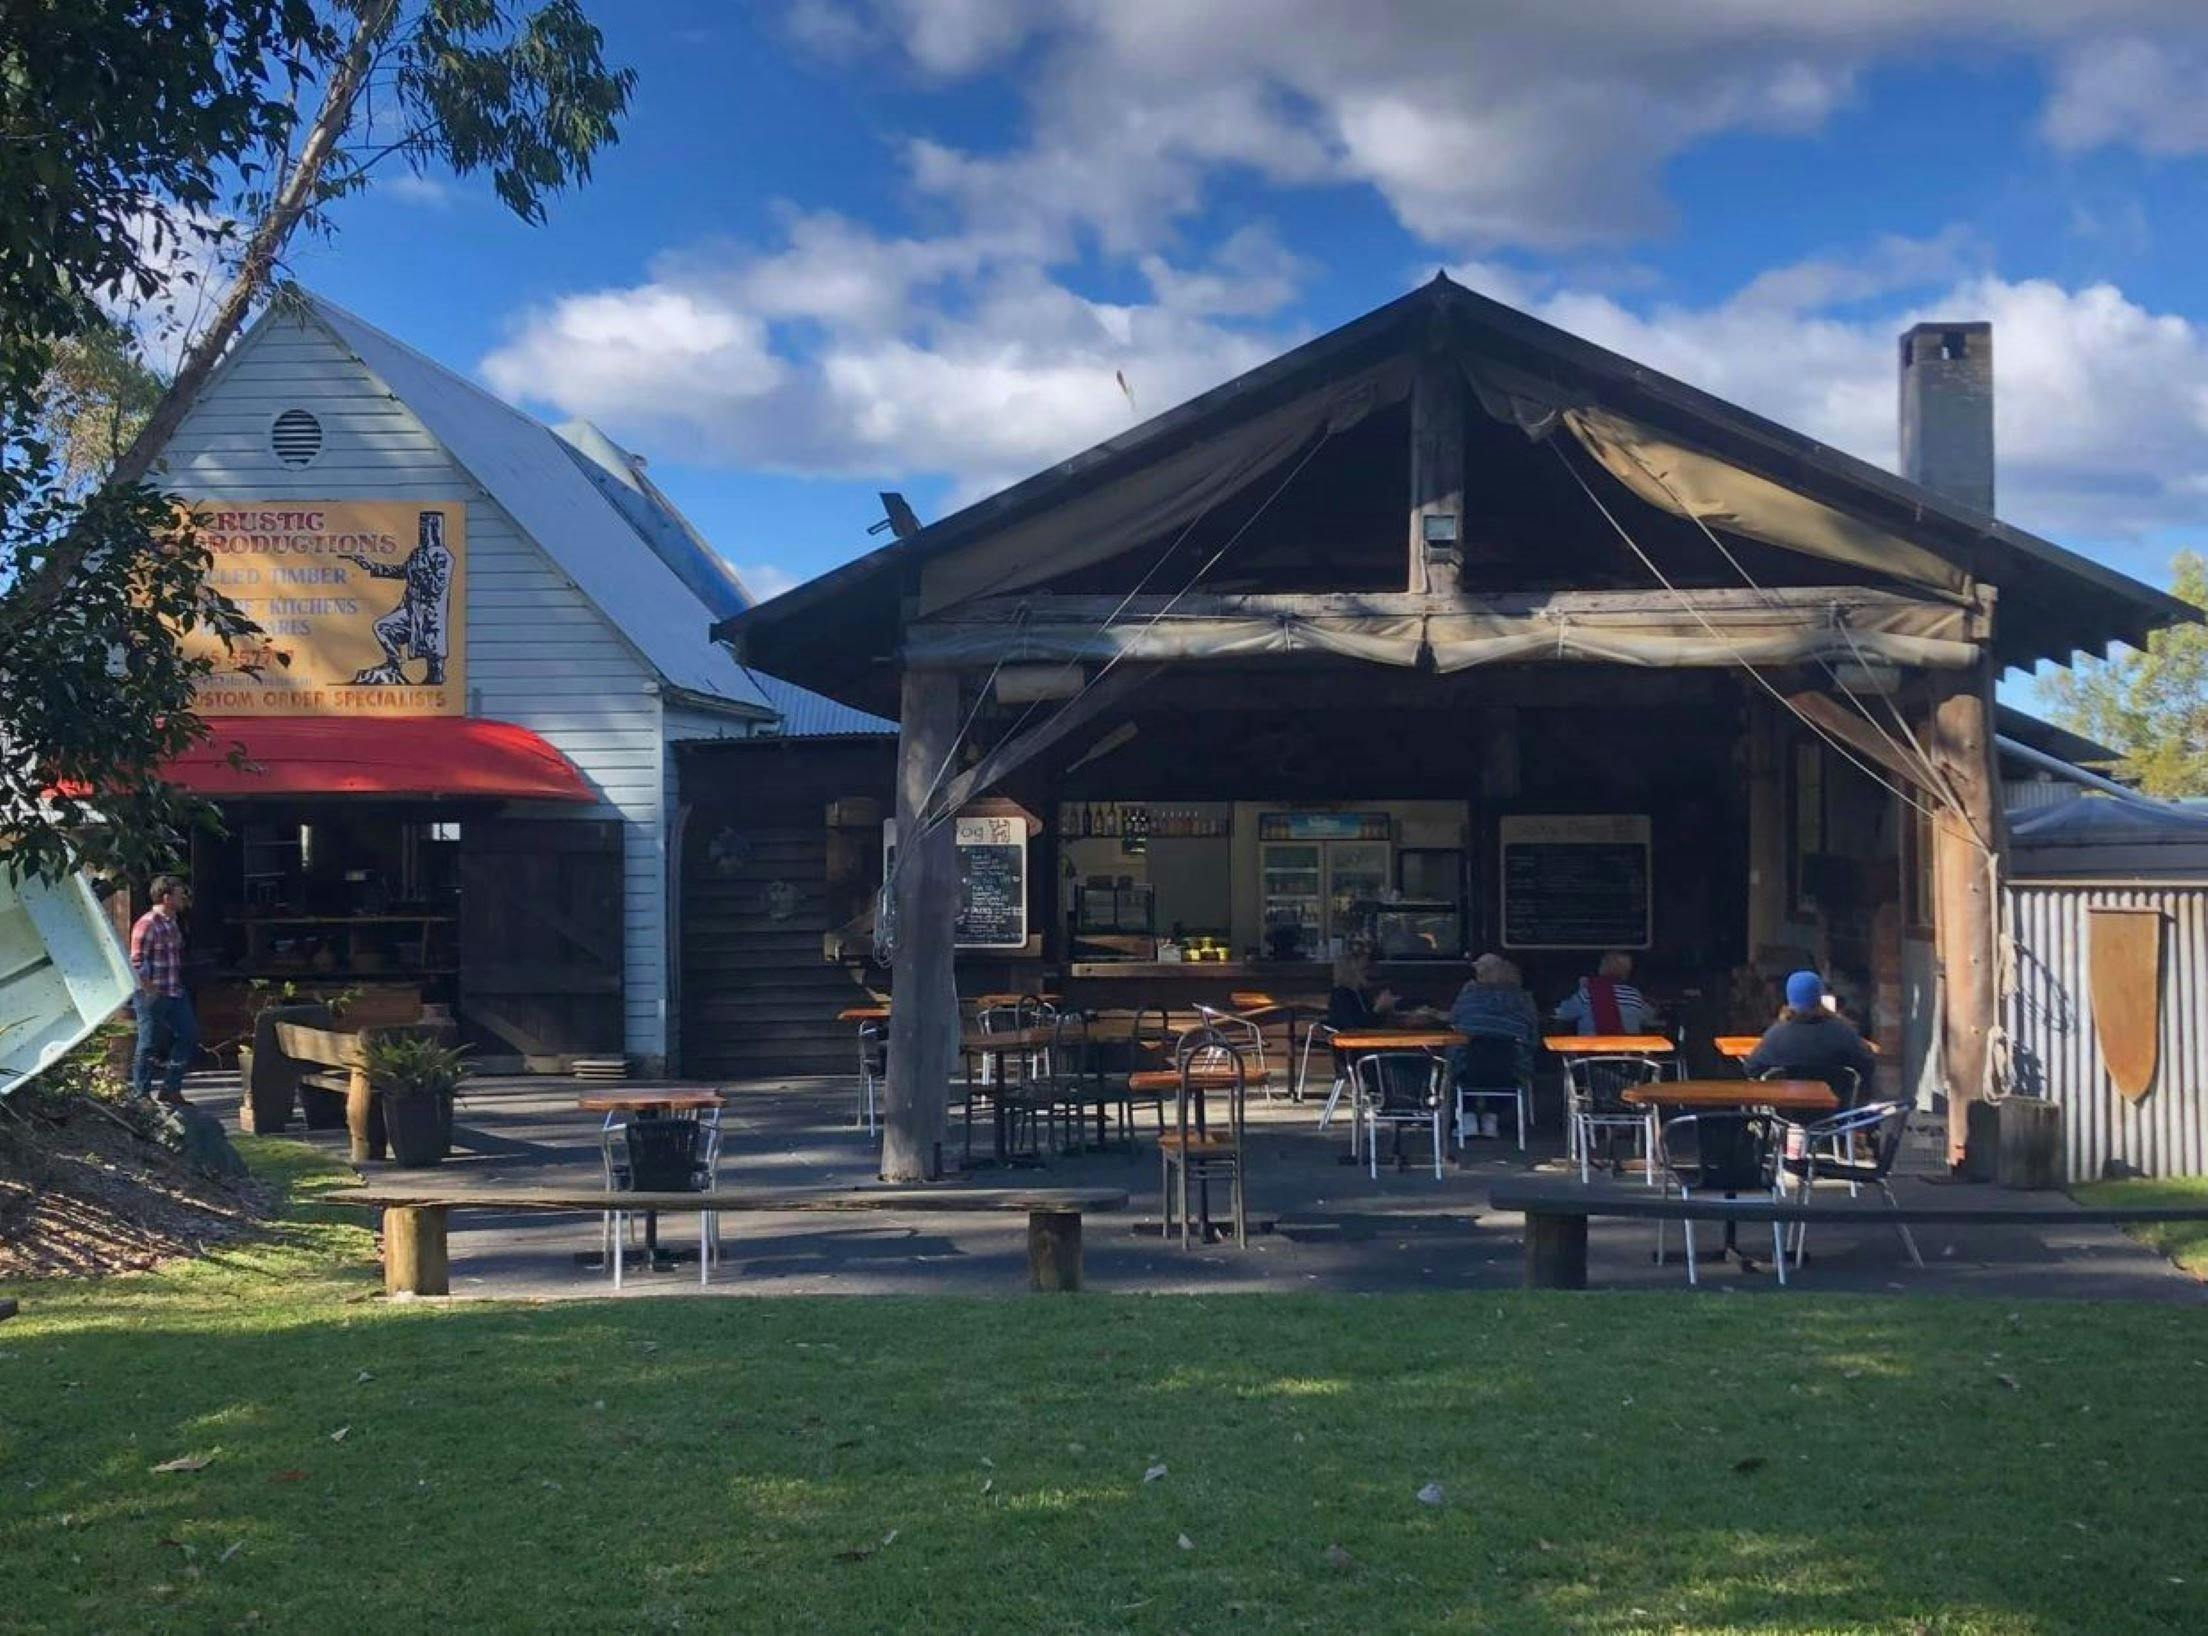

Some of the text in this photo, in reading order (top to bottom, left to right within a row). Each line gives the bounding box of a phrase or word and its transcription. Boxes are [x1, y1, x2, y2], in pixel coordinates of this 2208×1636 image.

[216, 511, 325, 532] RUSTIC
[205, 533, 398, 554] RODUCTIONS
[270, 567, 347, 585] TIMBER
[270, 597, 358, 615] KITCHENS
[196, 690, 447, 708] USTOM ORDER SPECIALISTS
